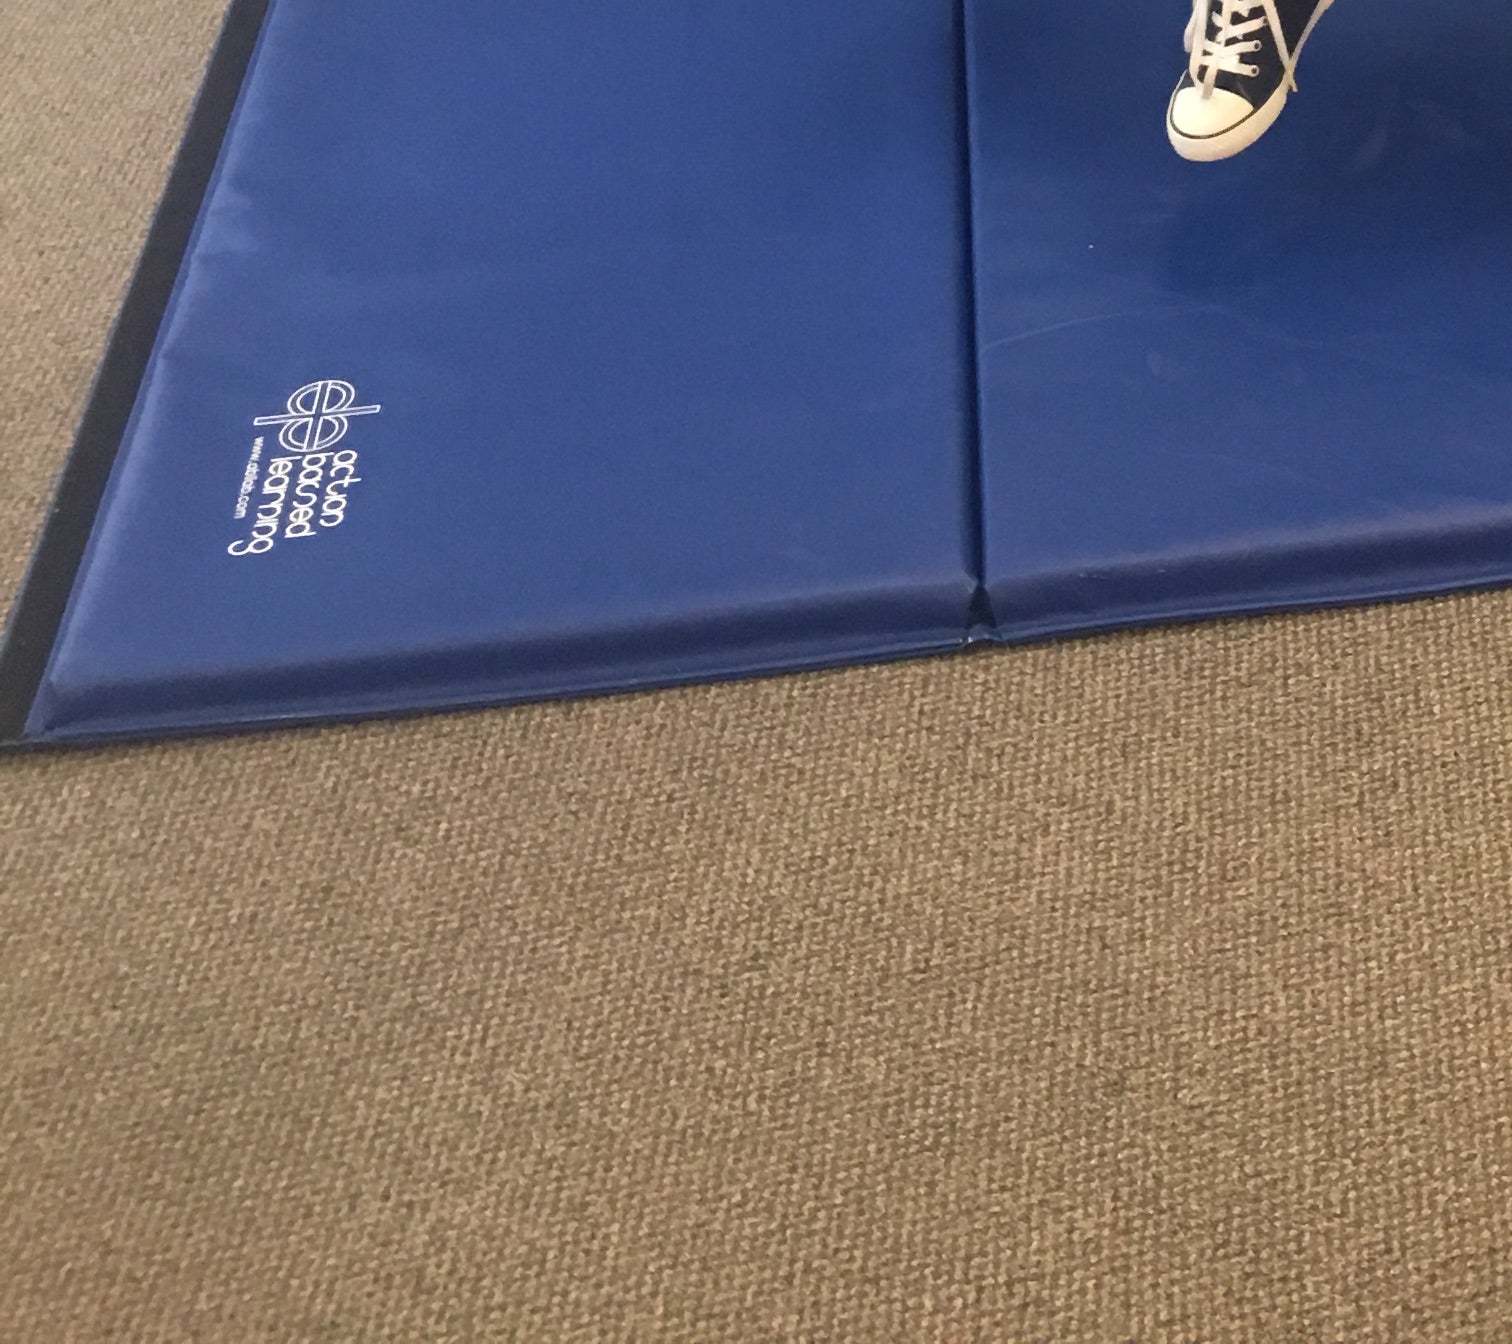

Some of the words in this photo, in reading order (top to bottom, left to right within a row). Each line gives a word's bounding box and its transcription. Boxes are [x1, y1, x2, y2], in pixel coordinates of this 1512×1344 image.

[227, 455, 303, 556] learning
[284, 452, 334, 538] based
[319, 449, 362, 527] action
